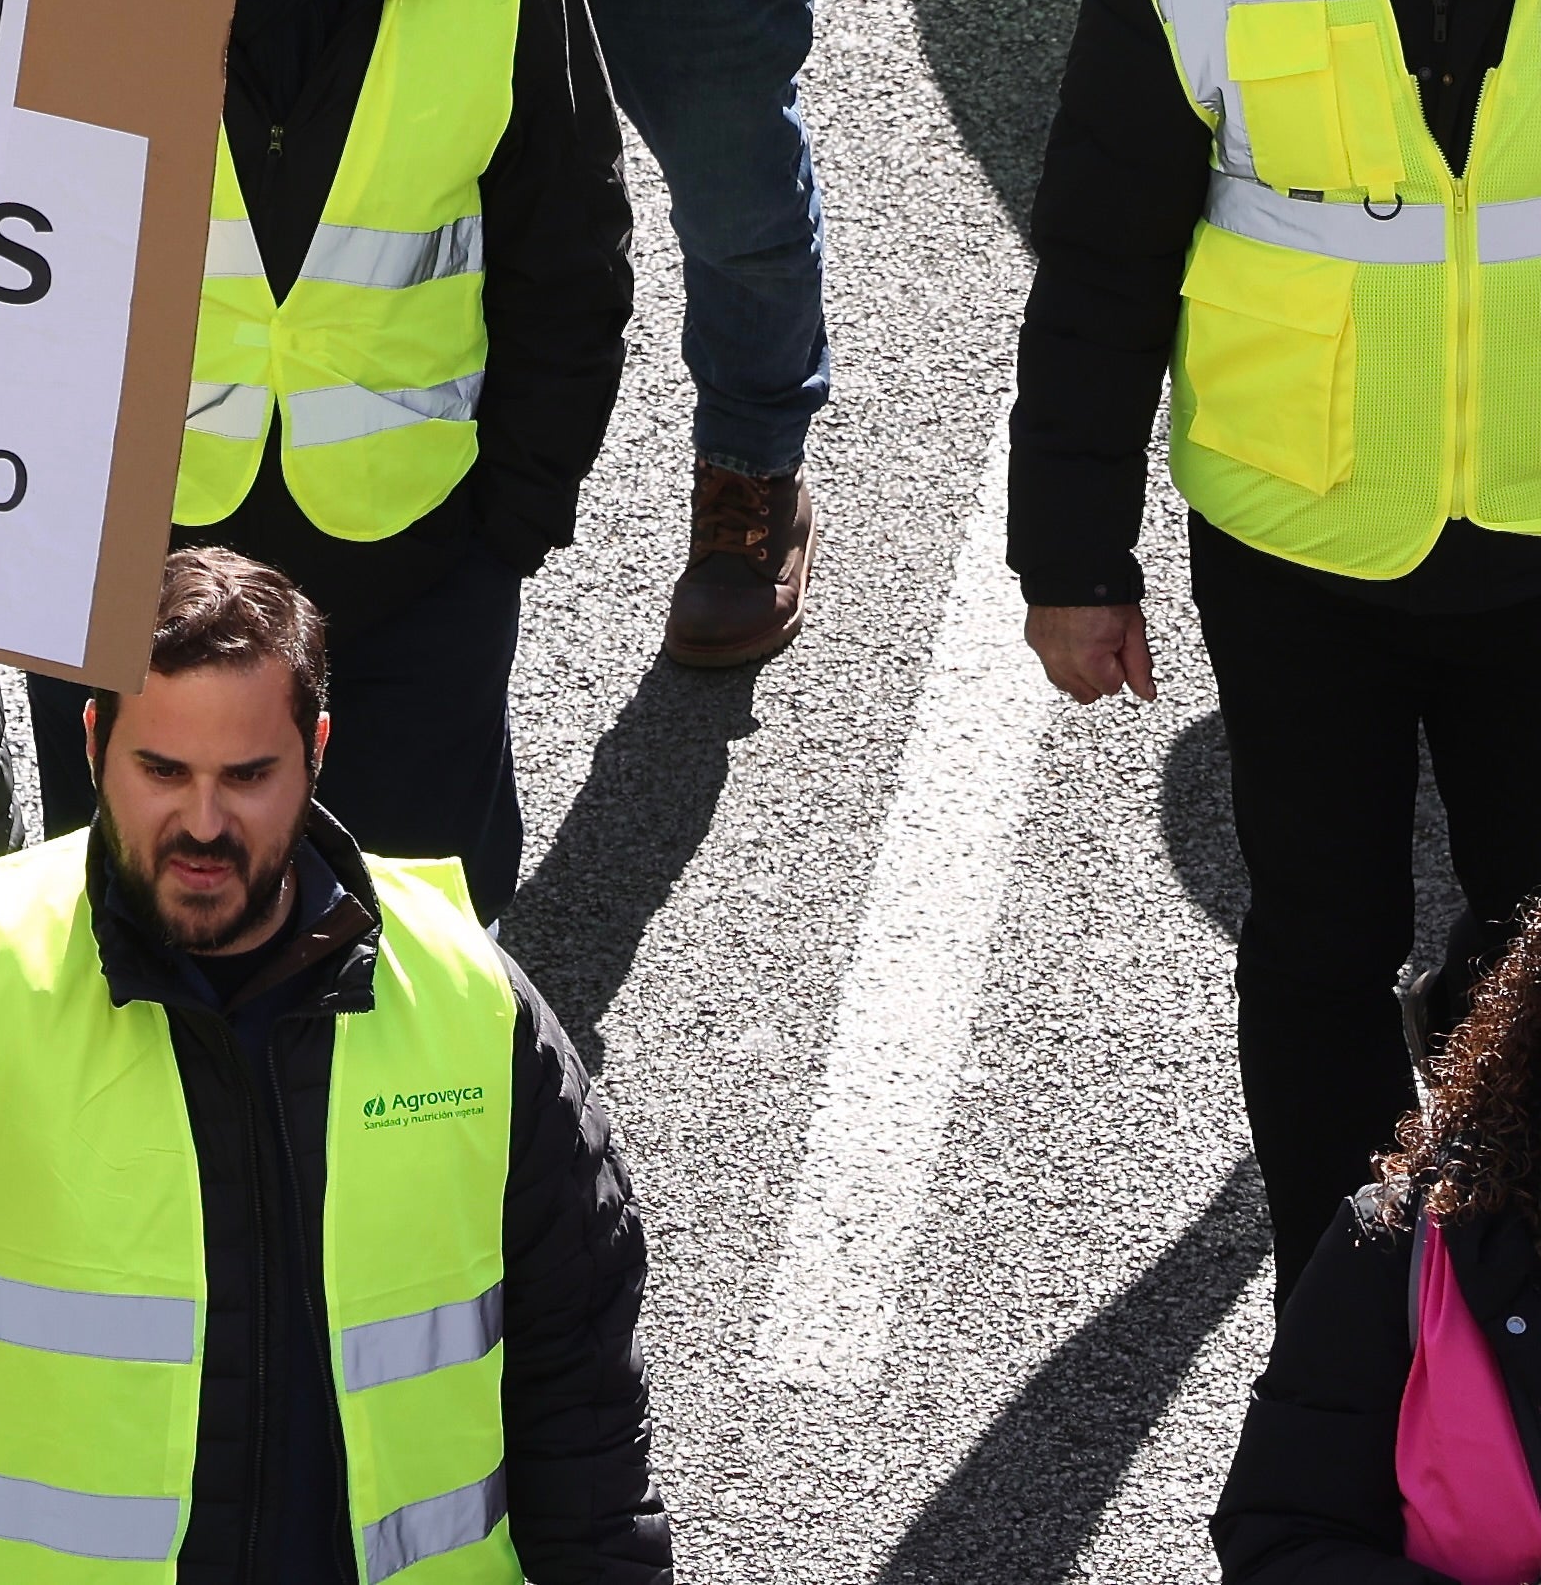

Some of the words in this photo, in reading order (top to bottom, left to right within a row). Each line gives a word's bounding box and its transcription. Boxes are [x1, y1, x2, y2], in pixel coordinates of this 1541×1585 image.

[392, 1086, 483, 1112] Agroveyca
[364, 1117, 401, 1130] Sanidad
[403, 1117, 409, 1127] y
[411, 1111, 453, 1124] nutrición
